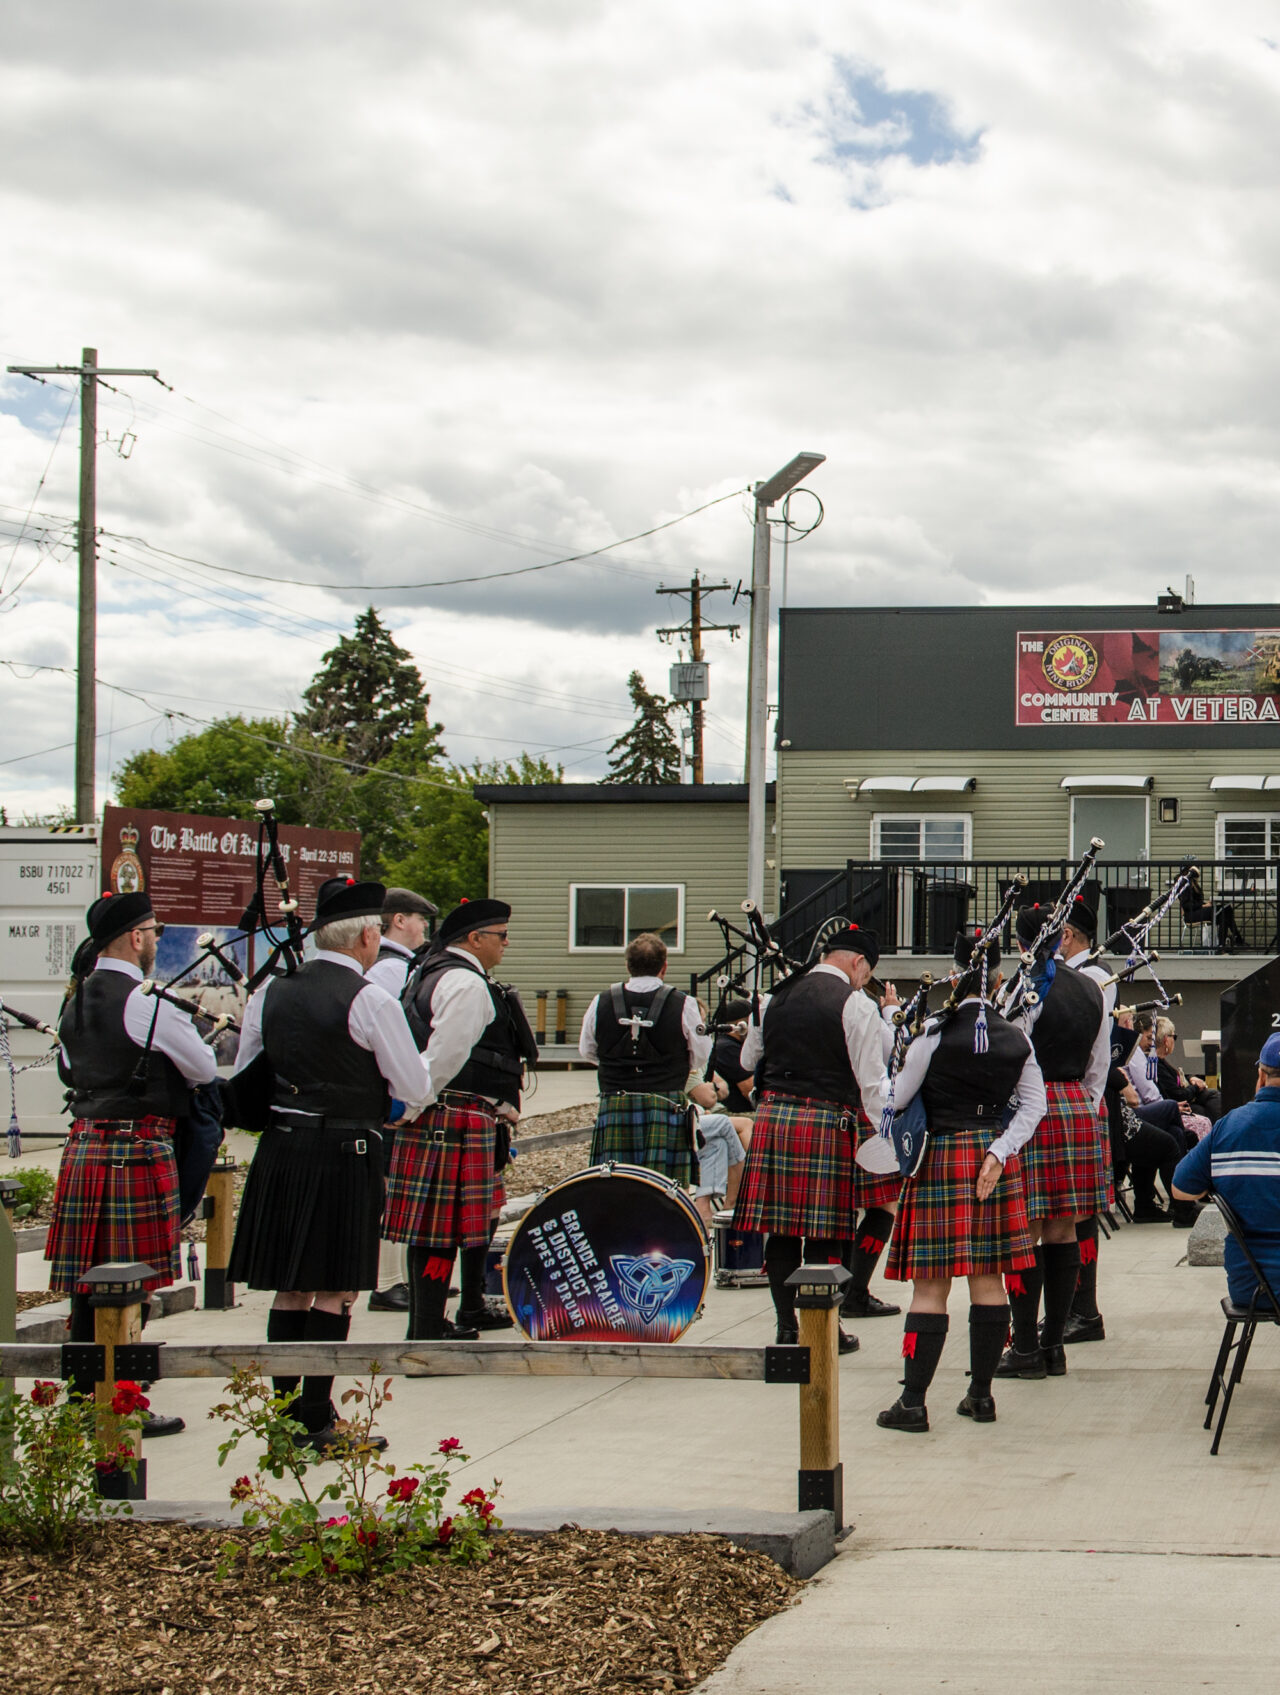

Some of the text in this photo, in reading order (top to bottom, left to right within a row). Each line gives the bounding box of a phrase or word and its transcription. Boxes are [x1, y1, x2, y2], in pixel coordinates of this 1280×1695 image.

[1021, 641, 1044, 653] THE
[1049, 638, 1090, 656] ORIGINAL
[1045, 663, 1094, 688] NINE RIDERS
[1021, 692, 1119, 707] COMMUNITY
[1041, 708, 1098, 722] CENTRE
[1127, 698, 1161, 721] AT
[150, 825, 177, 852] The
[180, 827, 218, 853] Battle
[220, 832, 239, 855] Of
[300, 846, 318, 863] April
[318, 849, 338, 863] 22-25
[338, 851, 354, 865] 1951
[20, 864, 94, 879] BSBU 717022 7
[46, 881, 70, 894] 45G1
[9, 925, 40, 938] MAX GR
[543, 1219, 591, 1298] & DISTRICT
[527, 1226, 585, 1328] PIPES & DRUMS
[561, 1209, 626, 1328] GRANDE PRAIRIE
